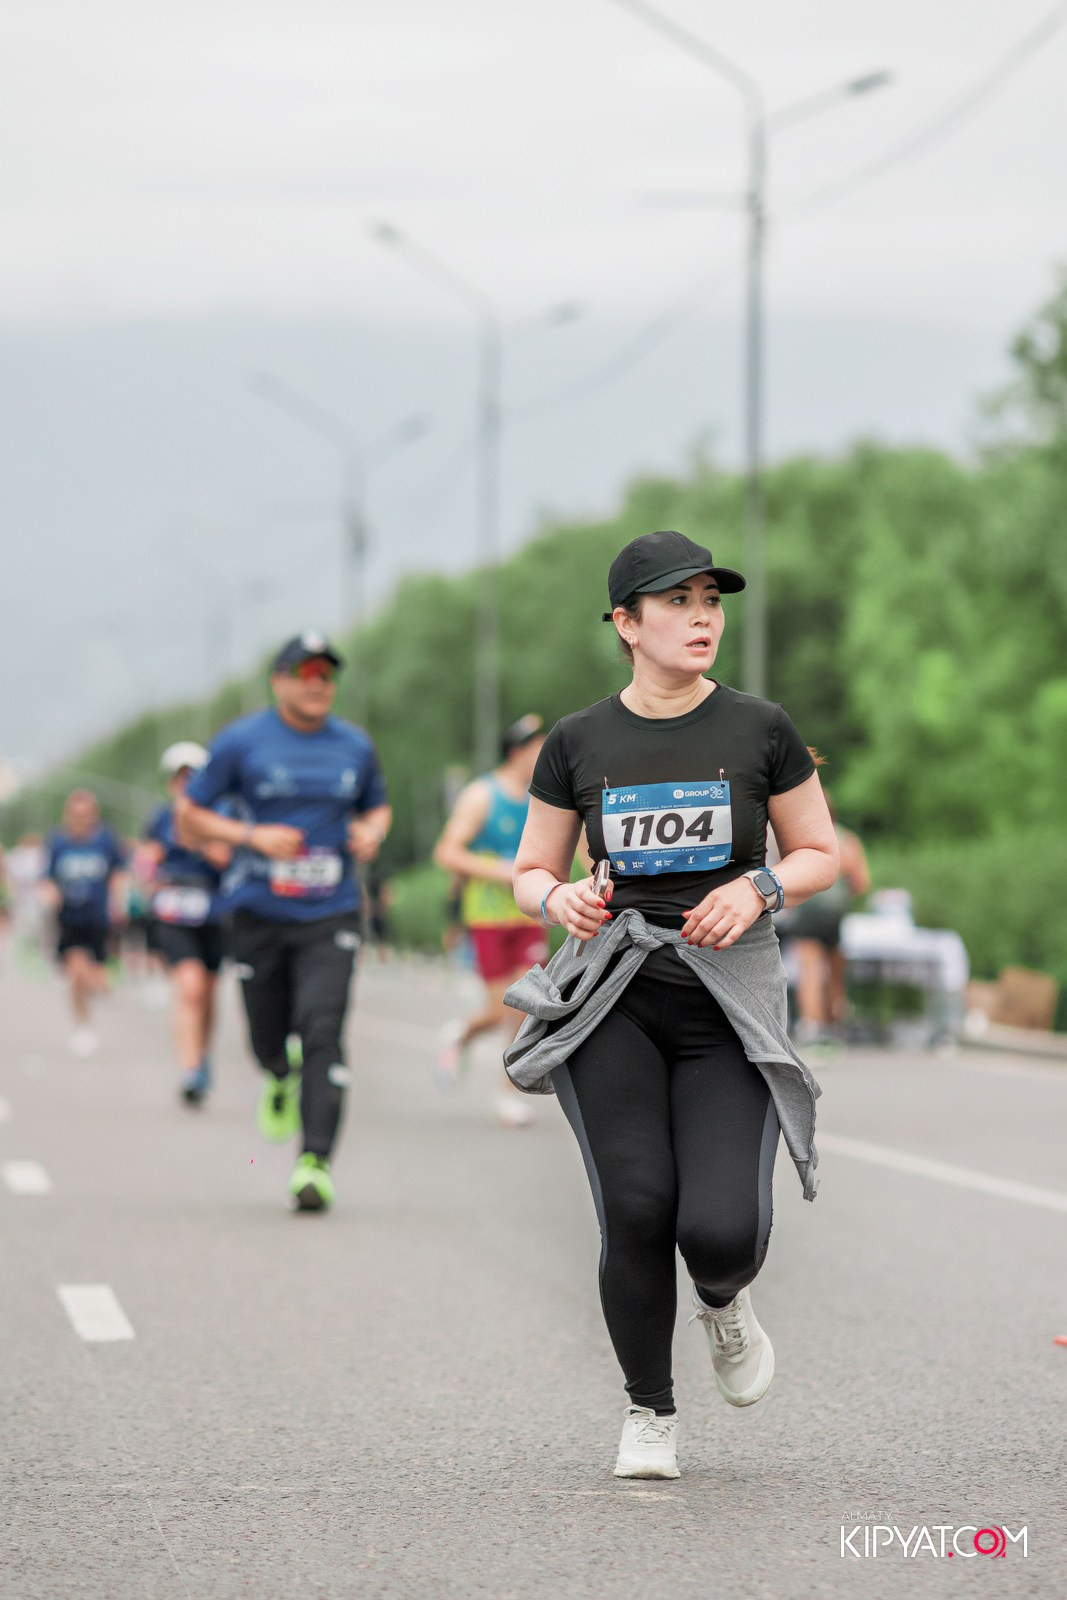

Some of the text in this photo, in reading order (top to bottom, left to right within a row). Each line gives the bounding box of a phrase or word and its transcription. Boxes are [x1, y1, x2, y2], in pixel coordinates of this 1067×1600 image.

[608, 794, 636, 805] 5 KM
[685, 790, 710, 798] GROUP
[621, 810, 714, 847] 1104
